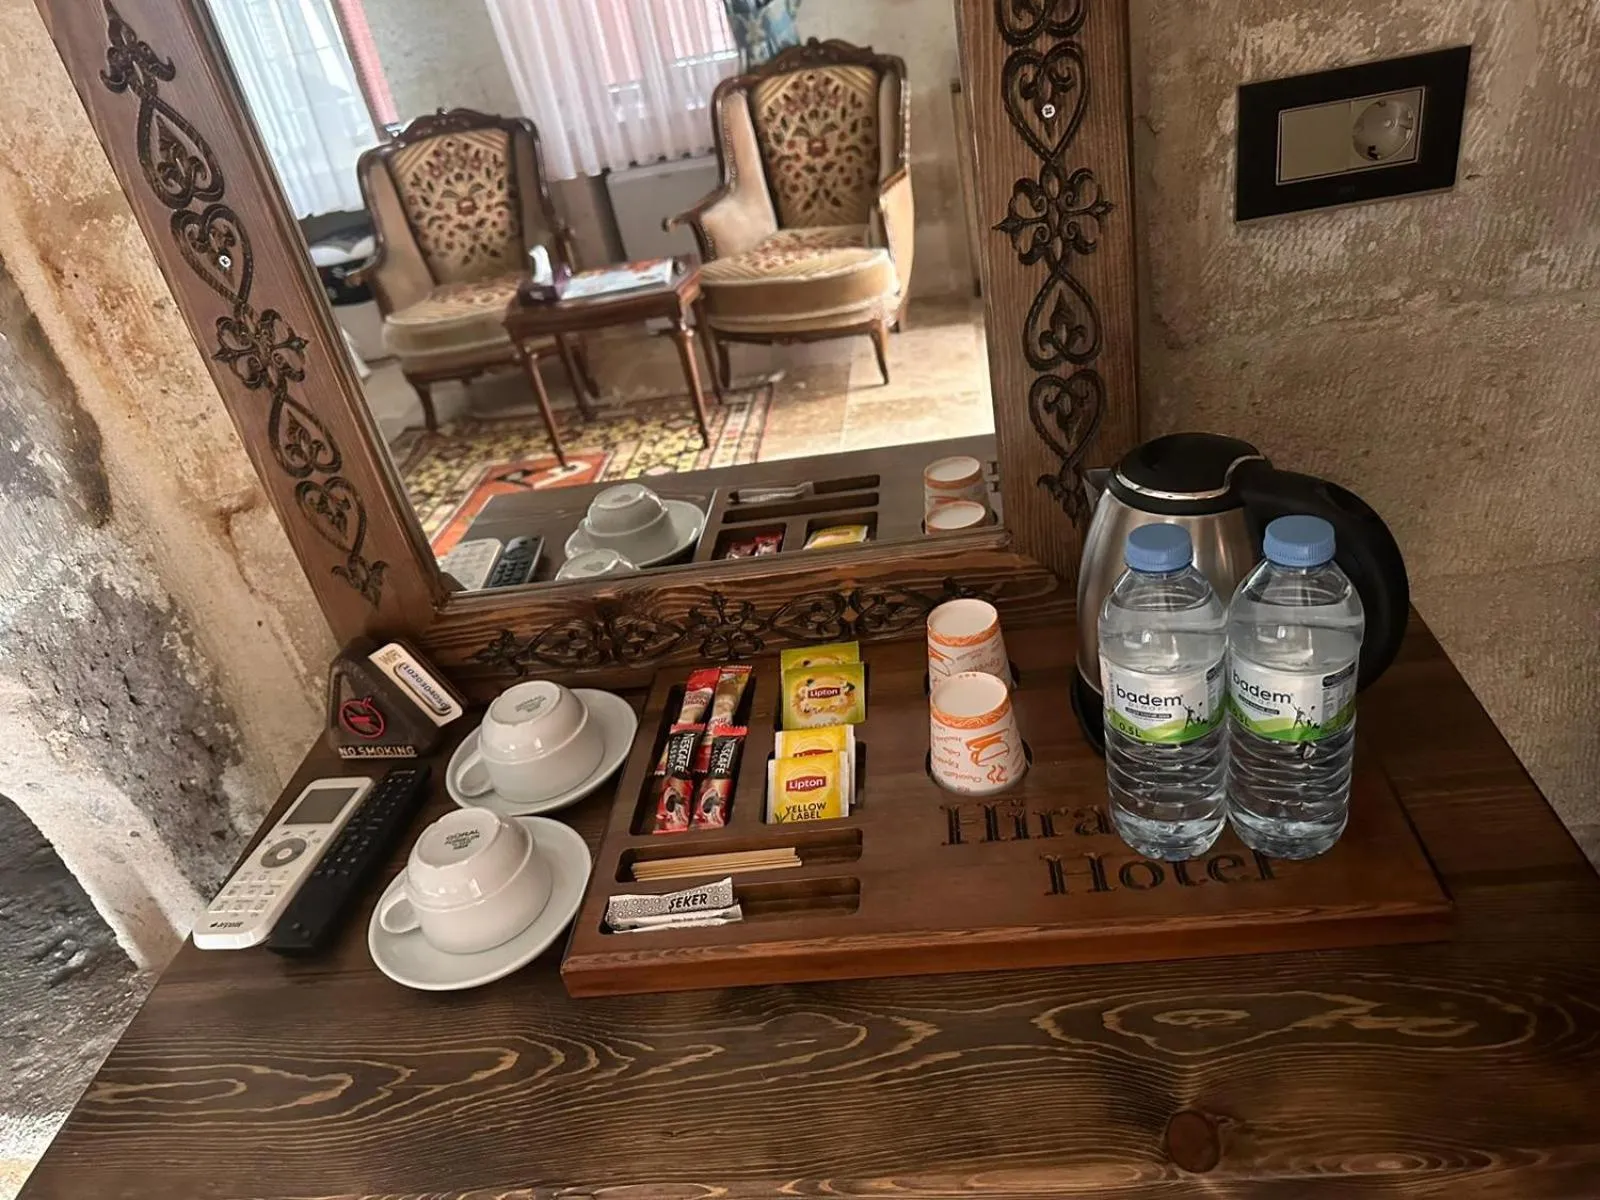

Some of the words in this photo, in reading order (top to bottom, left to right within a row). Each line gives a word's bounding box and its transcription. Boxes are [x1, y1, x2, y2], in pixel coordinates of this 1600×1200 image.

[1233, 669, 1292, 704] badem
[810, 689, 839, 698] Lipton
[1116, 684, 1182, 706] badem
[338, 746, 358, 757] NO
[358, 745, 416, 756] SMOKING
[788, 778, 824, 790] Lipton
[785, 802, 827, 814] YELLOW
[790, 810, 822, 821] LABEL
[1039, 848, 1277, 897] Hotel
